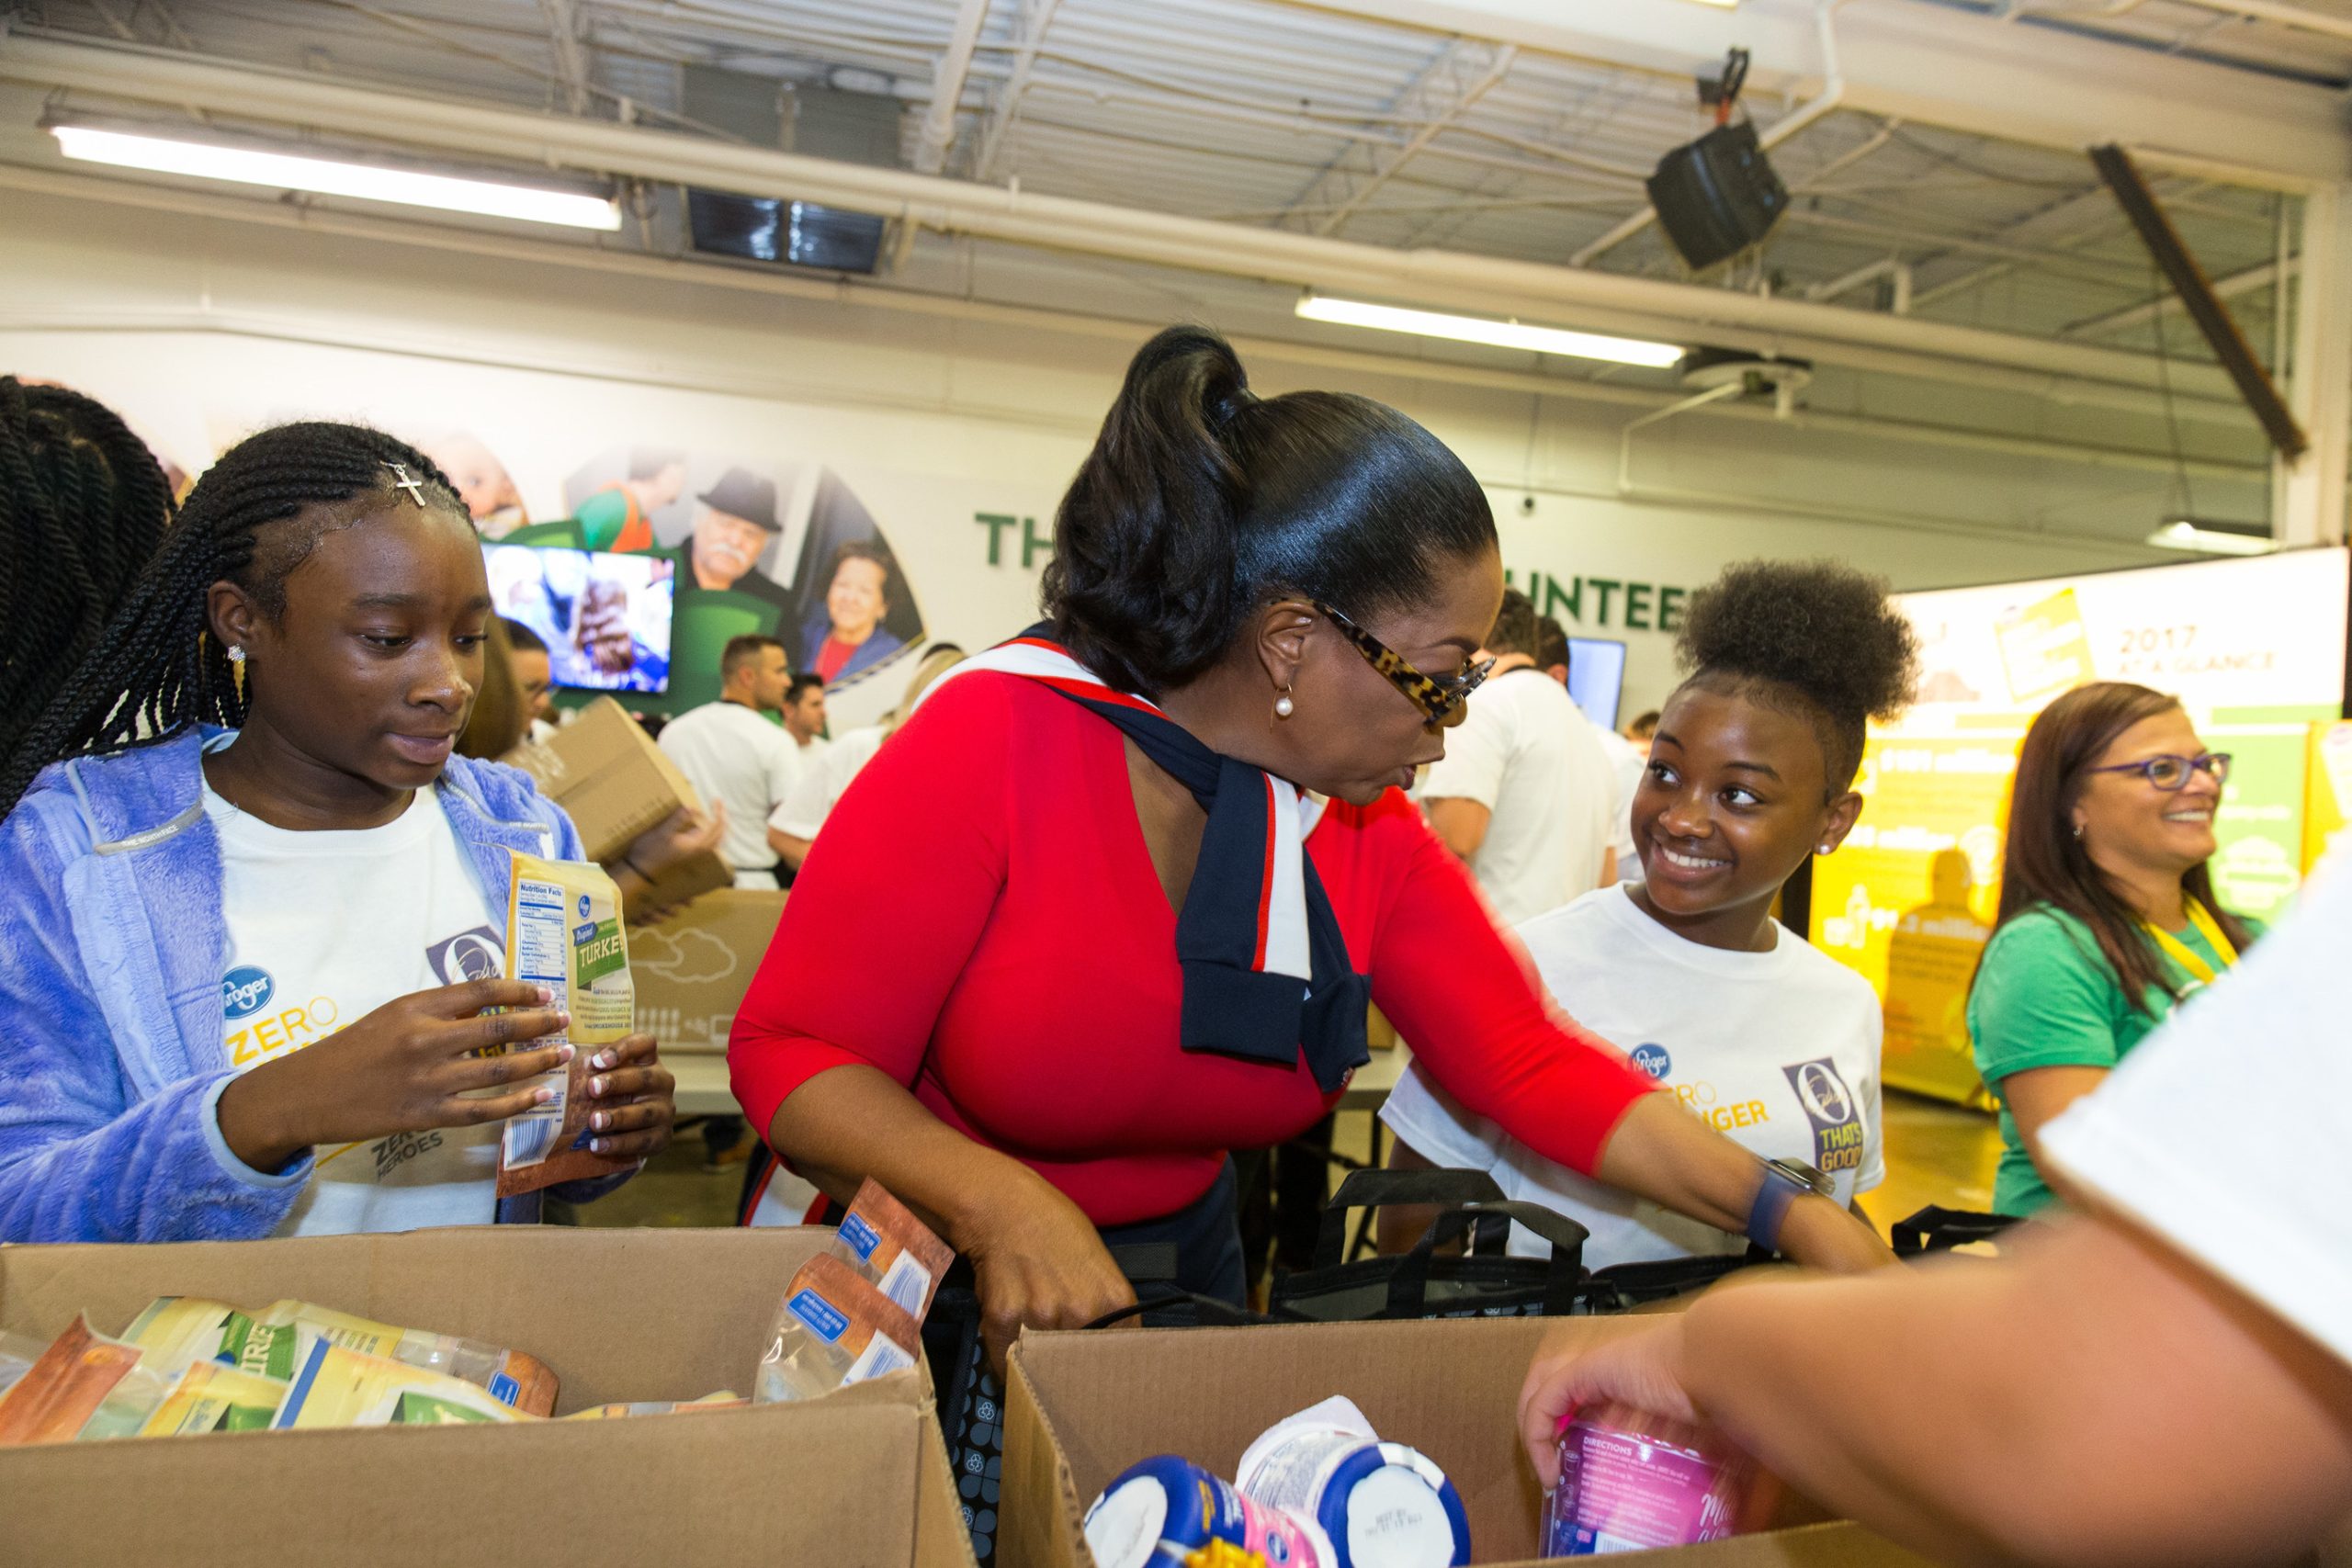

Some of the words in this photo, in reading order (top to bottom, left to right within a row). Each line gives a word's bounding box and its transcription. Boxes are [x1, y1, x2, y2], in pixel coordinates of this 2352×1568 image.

[975, 513, 1054, 568] TH
[1506, 569, 1685, 631] NTEE
[2120, 626, 2199, 654] 2017
[521, 883, 548, 894] Nutrition
[548, 886, 562, 897] Facts
[225, 996, 338, 1066] ZERO
[1632, 1049, 1668, 1077] Kroger
[1675, 1081, 1716, 1106] RO
[1702, 1100, 1770, 1132] GER
[371, 1131, 413, 1167] ZER
[377, 1131, 444, 1179] HEROES
[241, 1321, 275, 1376] URKE
[1583, 1436, 1633, 1456] DIRECTIONS
